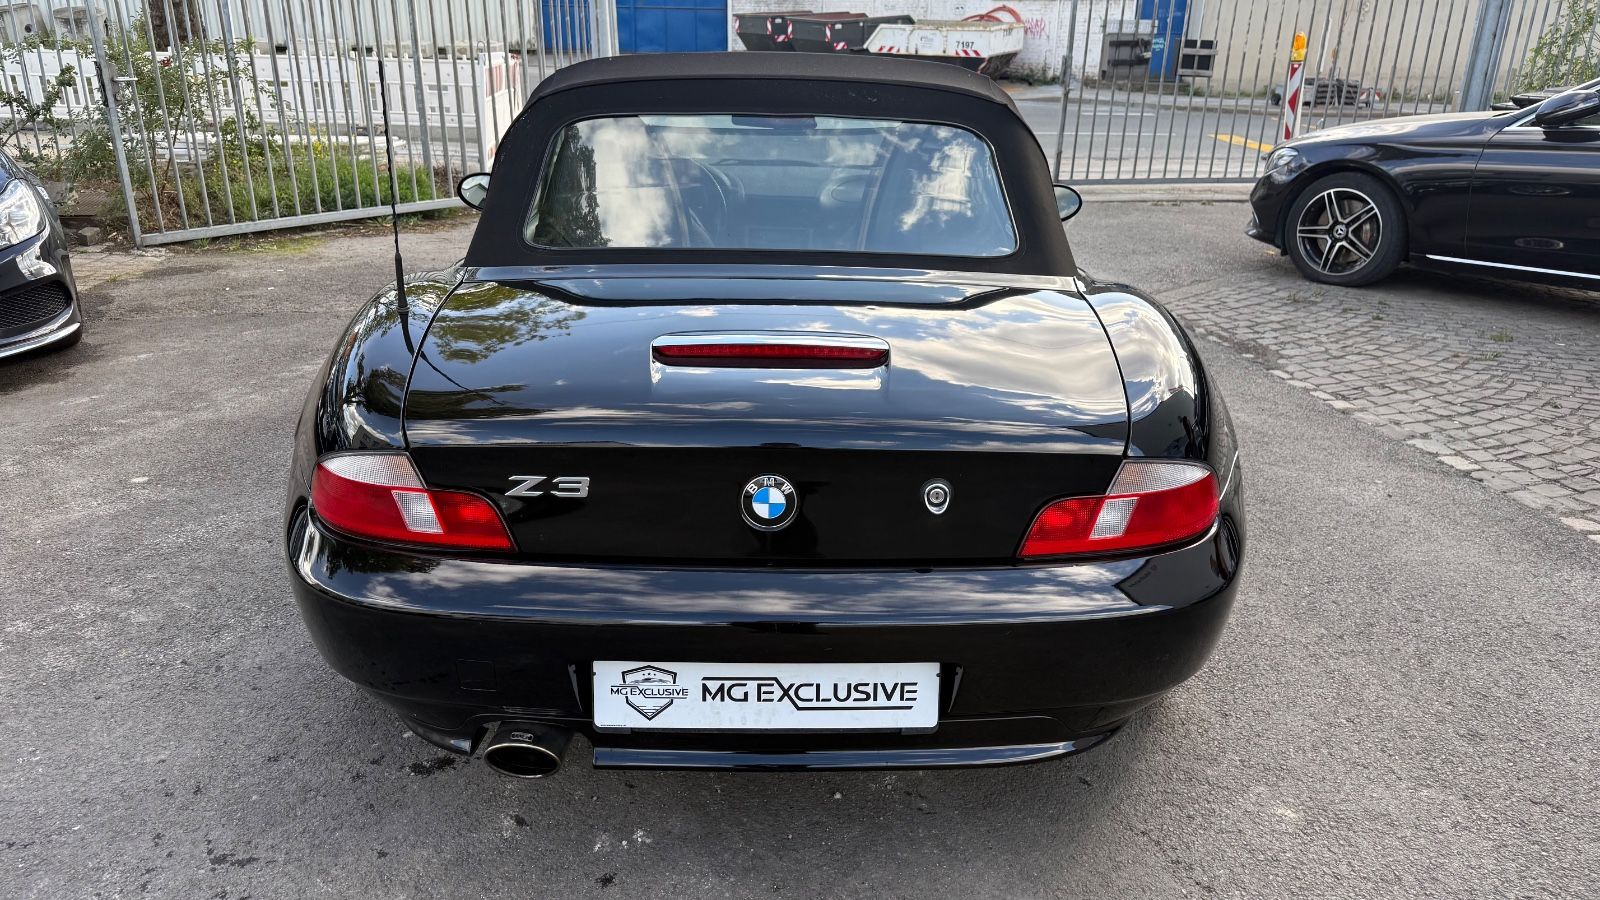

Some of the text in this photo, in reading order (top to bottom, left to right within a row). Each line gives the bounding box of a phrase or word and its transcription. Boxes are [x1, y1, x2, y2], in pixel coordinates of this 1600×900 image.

[956, 41, 975, 49] 7197
[505, 475, 590, 498] Z3
[747, 477, 793, 495] BMW
[610, 688, 689, 697] MG EXCLUSIVE
[701, 682, 918, 703] MG EXCLUSIVE
